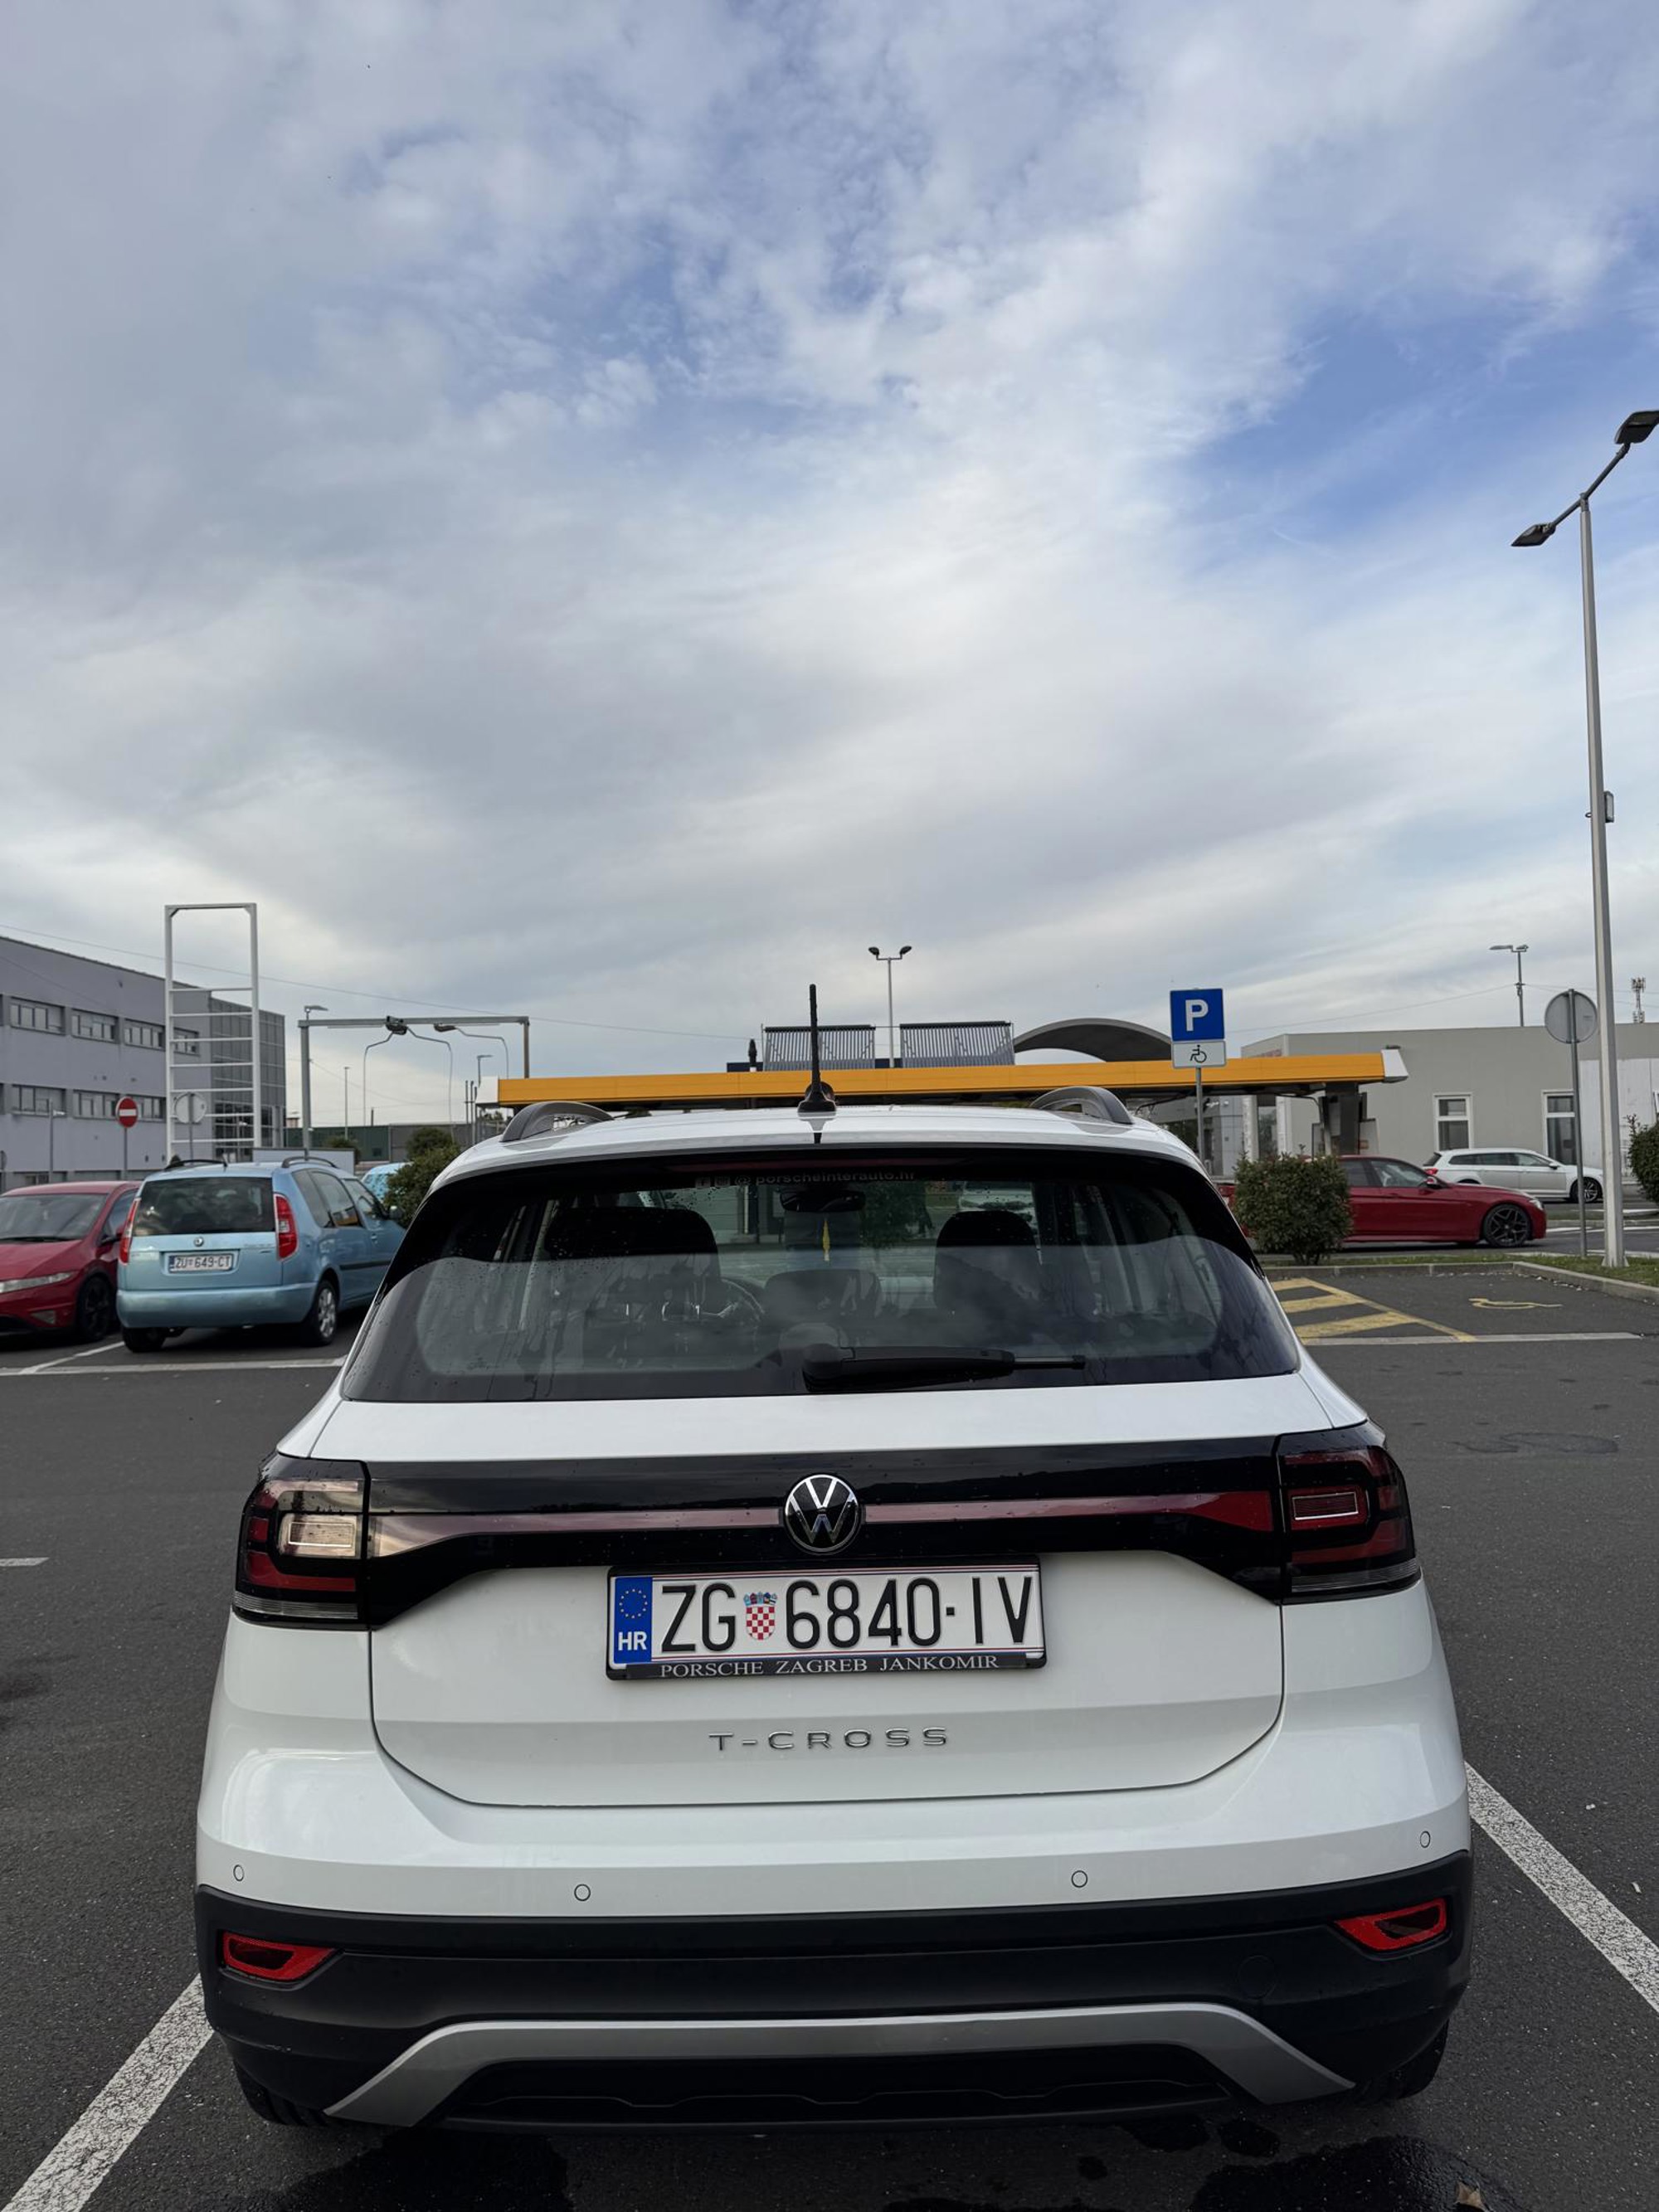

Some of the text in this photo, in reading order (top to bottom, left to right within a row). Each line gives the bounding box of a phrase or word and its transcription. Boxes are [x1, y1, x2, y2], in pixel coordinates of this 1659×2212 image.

[1185, 999, 1209, 1032] P
[661, 1582, 736, 1653] ZG
[618, 1631, 648, 1651] HR
[660, 1655, 1000, 1678] PORSCHE ZAGREB JANKOMIR
[708, 1727, 947, 1751] T-CROSS
